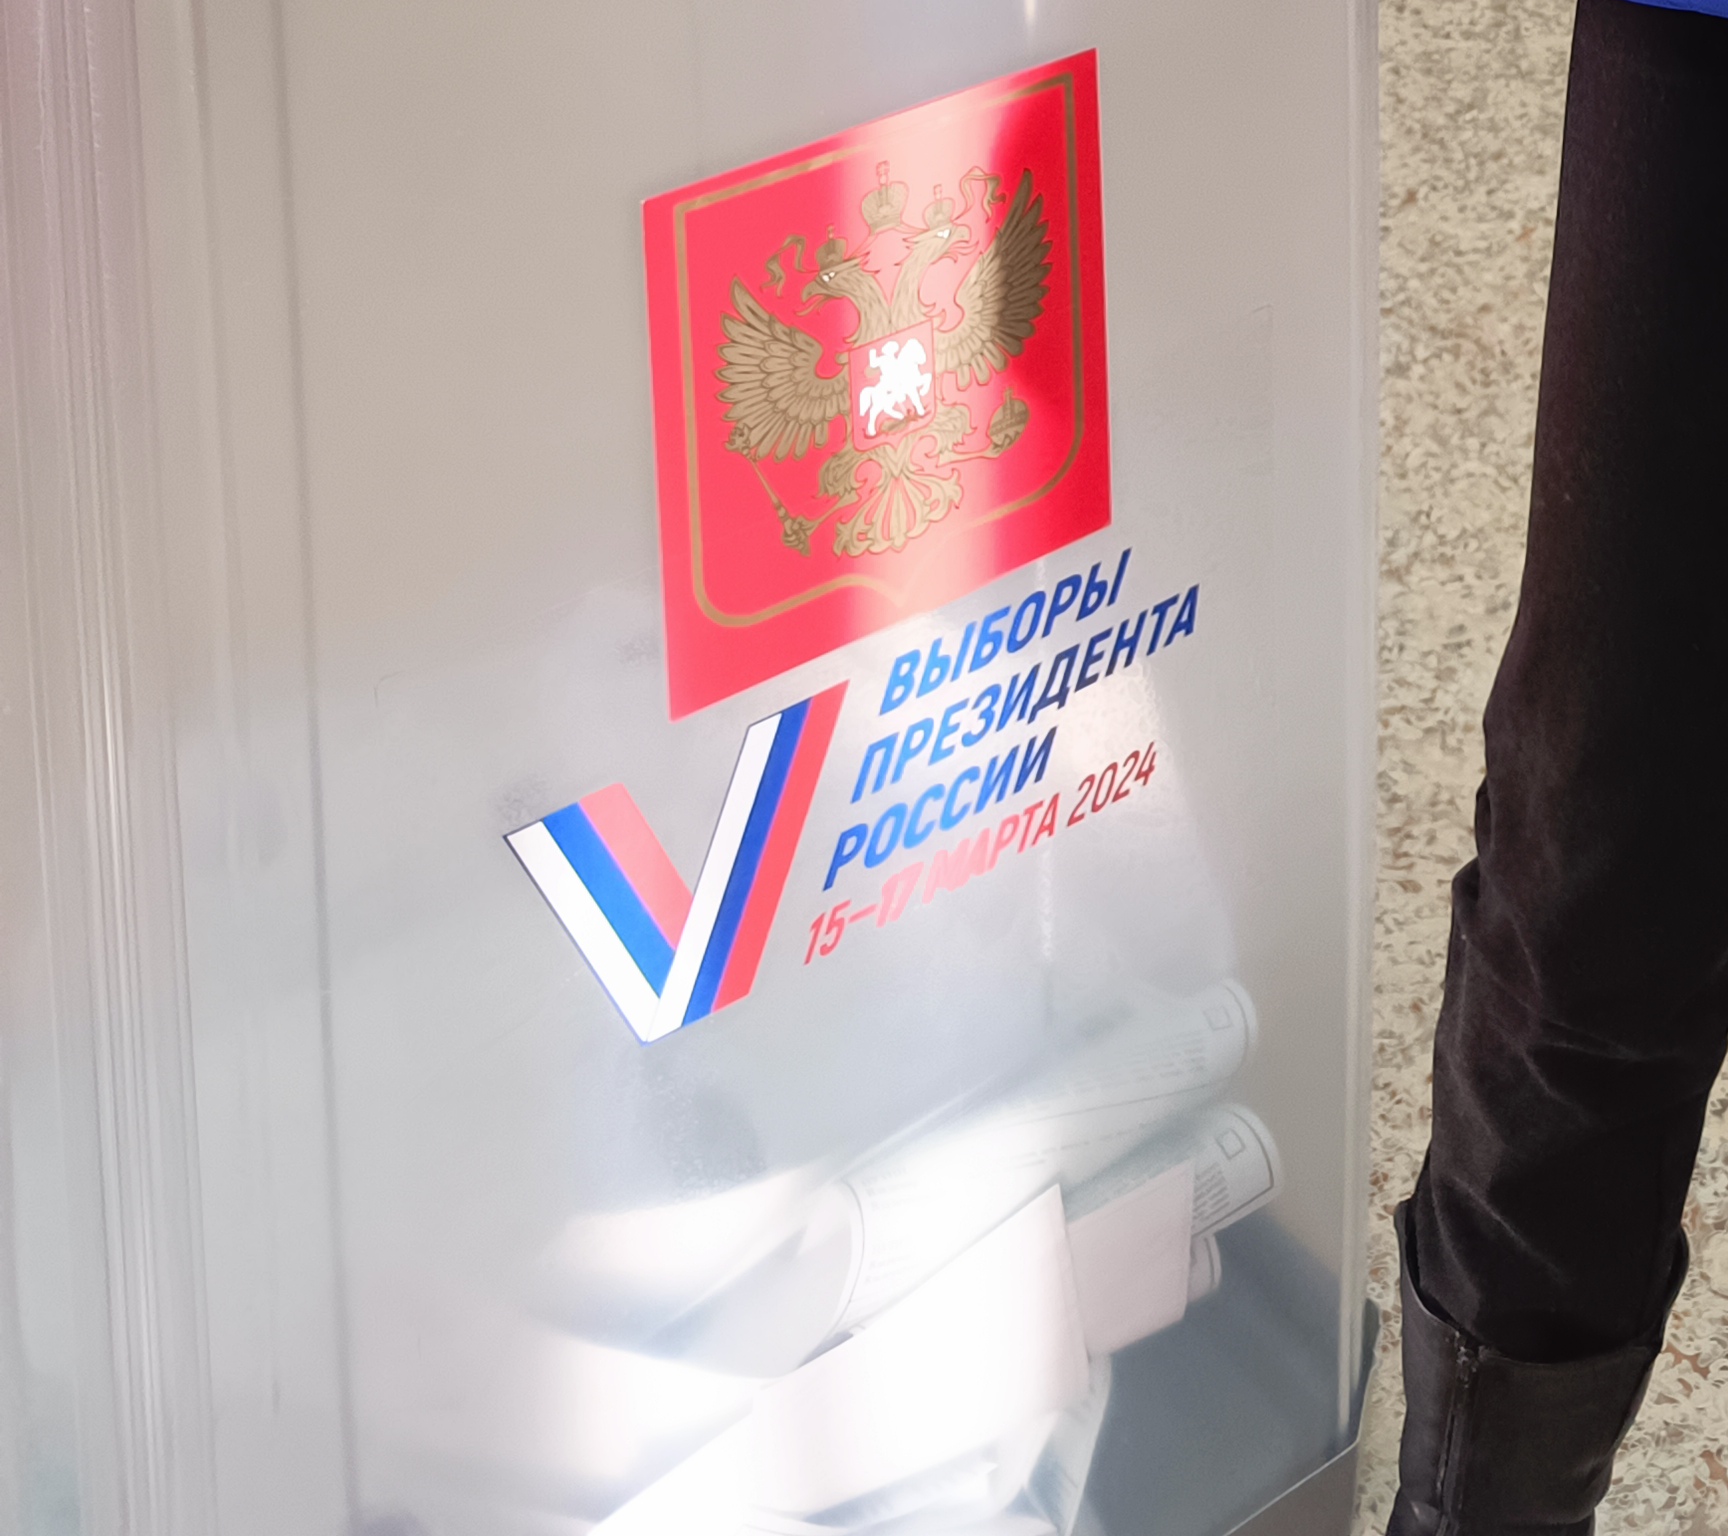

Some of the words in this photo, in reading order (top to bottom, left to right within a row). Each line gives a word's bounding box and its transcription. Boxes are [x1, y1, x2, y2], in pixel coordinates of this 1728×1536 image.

[851, 583, 1200, 805] ПРЕЗИДЕНТА
[879, 546, 1133, 717] ВЫБОРЫ
[822, 725, 1059, 893] РОССИИ
[921, 792, 1061, 905] МАРТА
[1066, 741, 1157, 828] 2024
